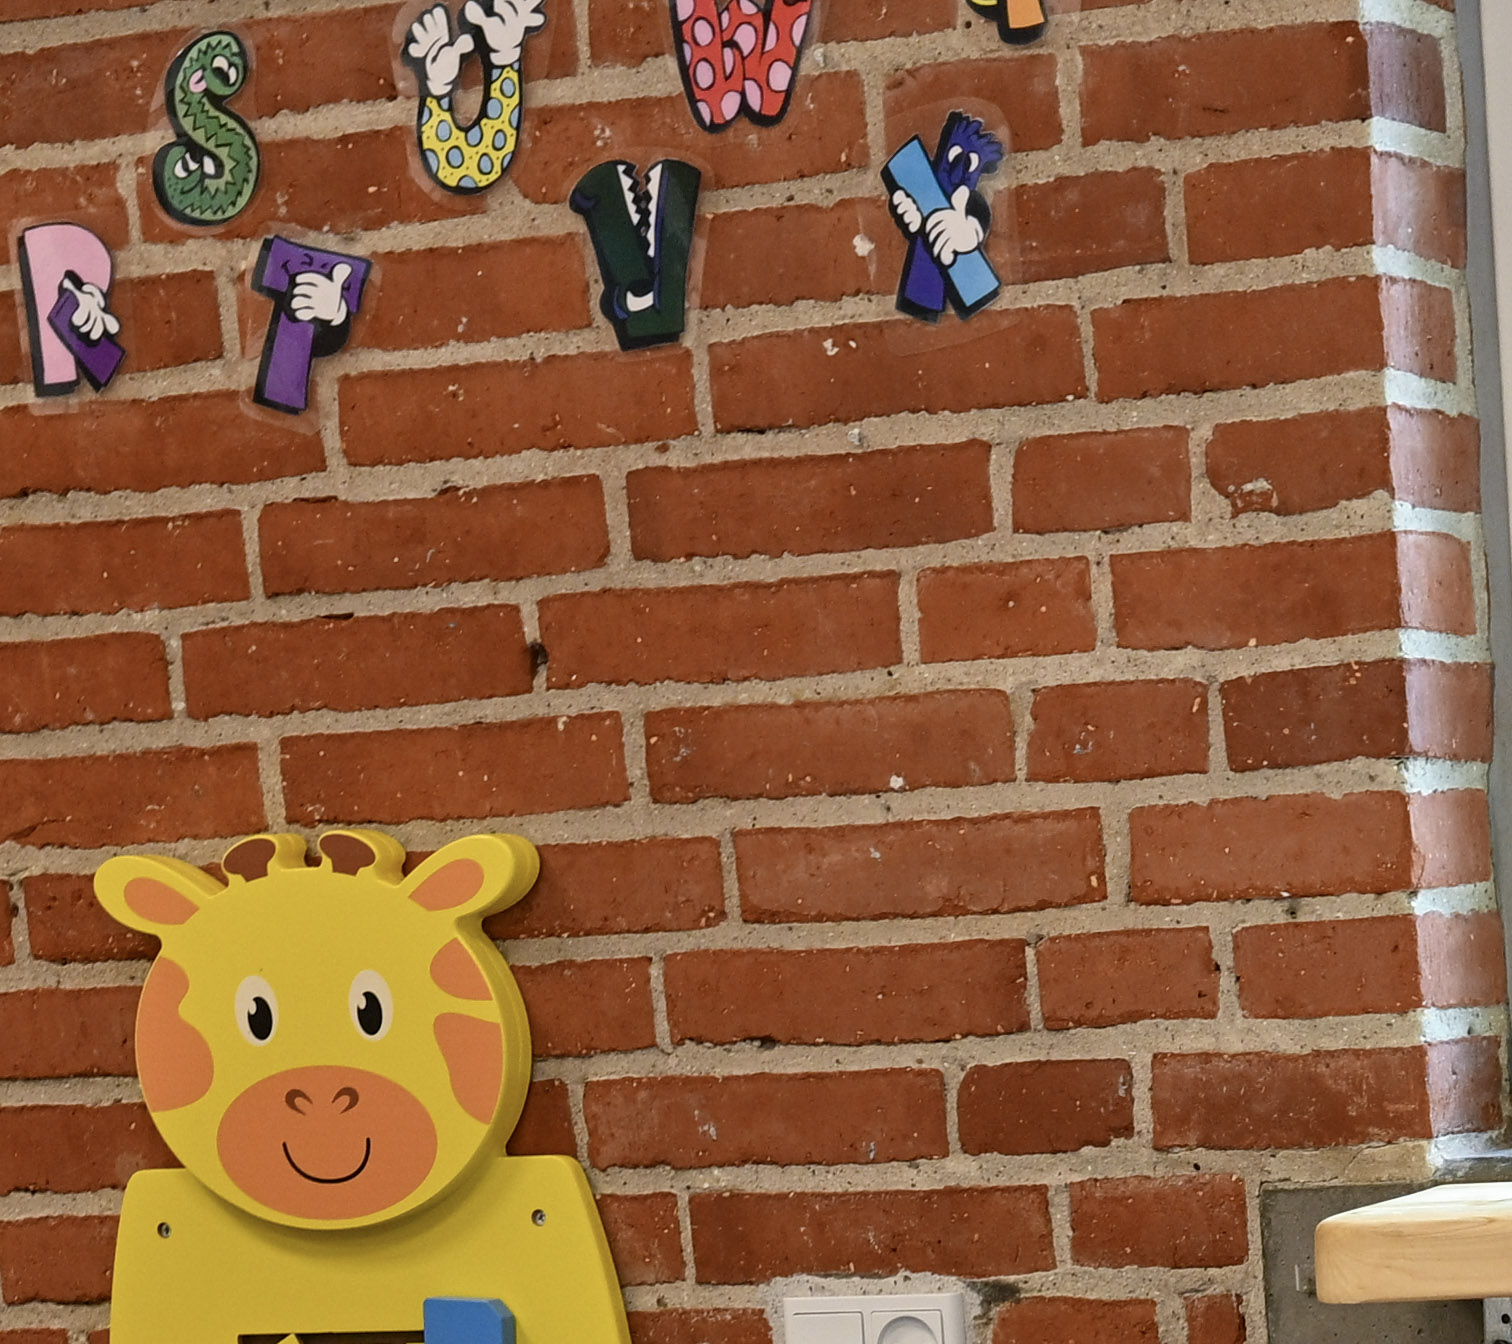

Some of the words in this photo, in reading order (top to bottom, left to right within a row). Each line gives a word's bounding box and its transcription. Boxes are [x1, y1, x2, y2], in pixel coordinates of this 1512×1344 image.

[18, 222, 125, 397] R
[152, 31, 260, 226] S
[251, 235, 372, 414] T
[402, 0, 546, 195] U
[570, 160, 701, 351] V
[882, 110, 1004, 322] X
